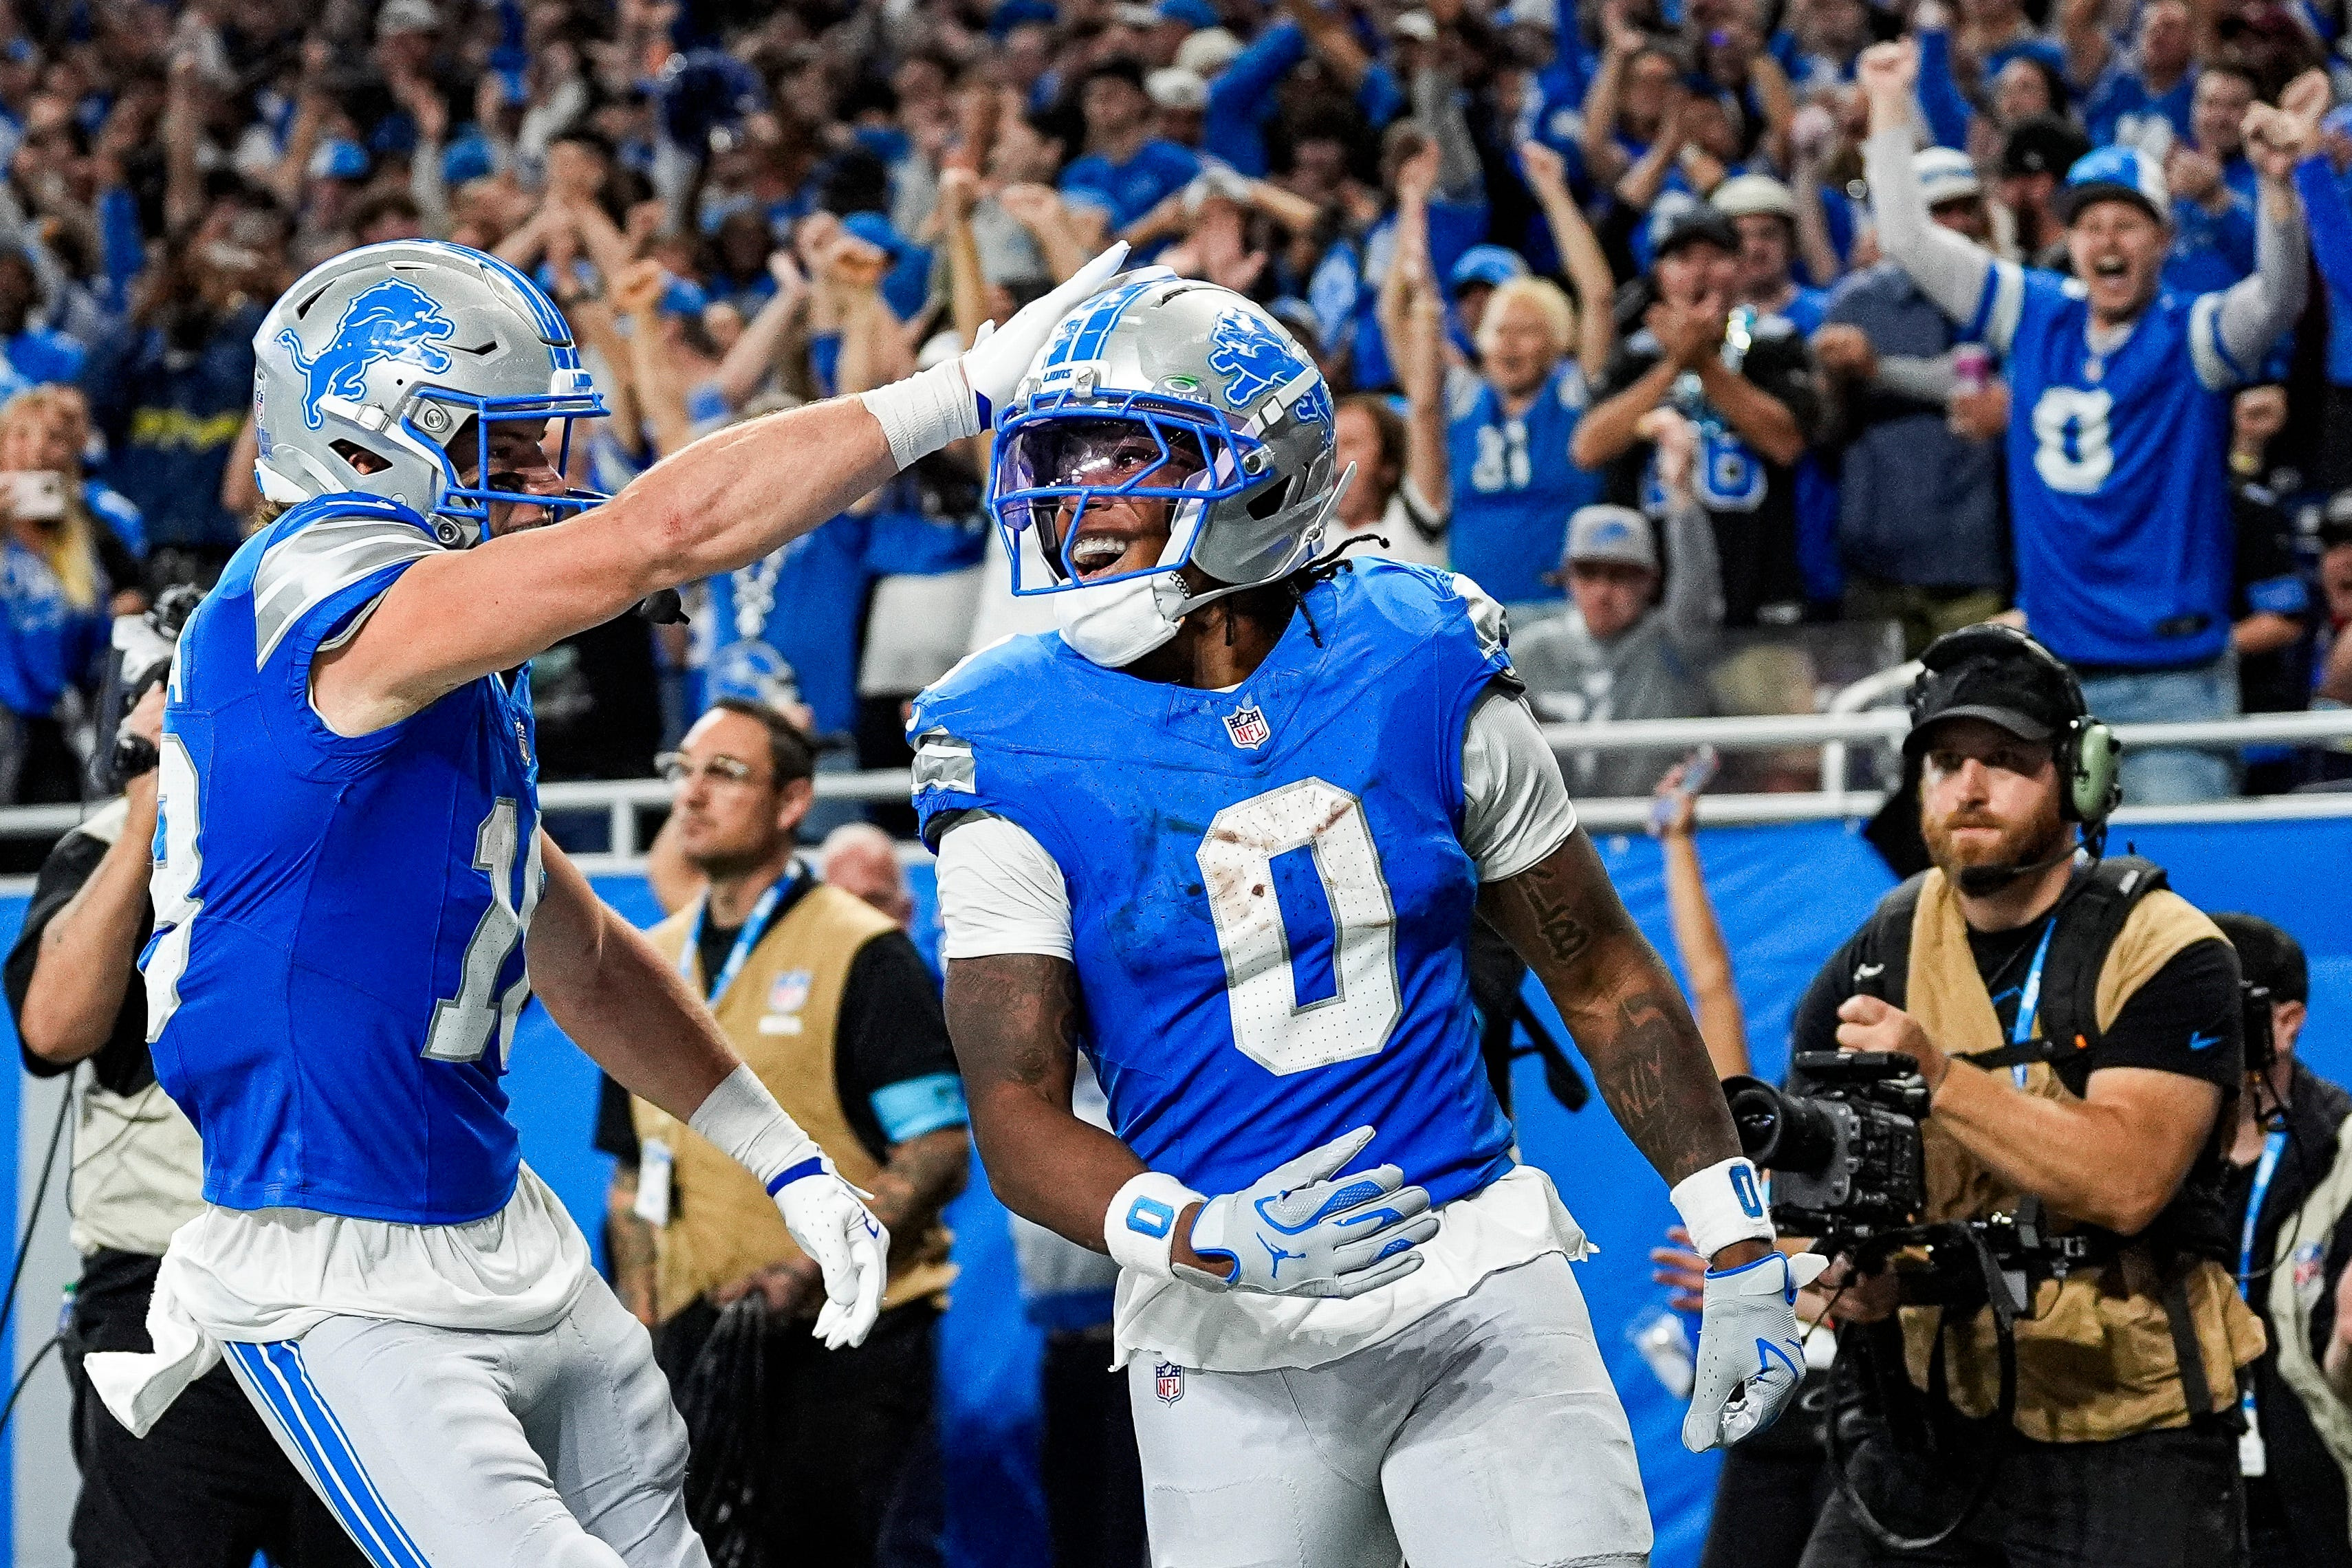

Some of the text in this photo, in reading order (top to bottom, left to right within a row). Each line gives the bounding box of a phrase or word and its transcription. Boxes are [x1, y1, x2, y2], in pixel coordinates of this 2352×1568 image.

[1236, 723, 1265, 742] NFL
[1195, 776, 1404, 1077] 0
[1729, 1165, 1763, 1219] 0
[1126, 1195, 1175, 1241] 0
[1158, 1378, 1179, 1397] NFL
